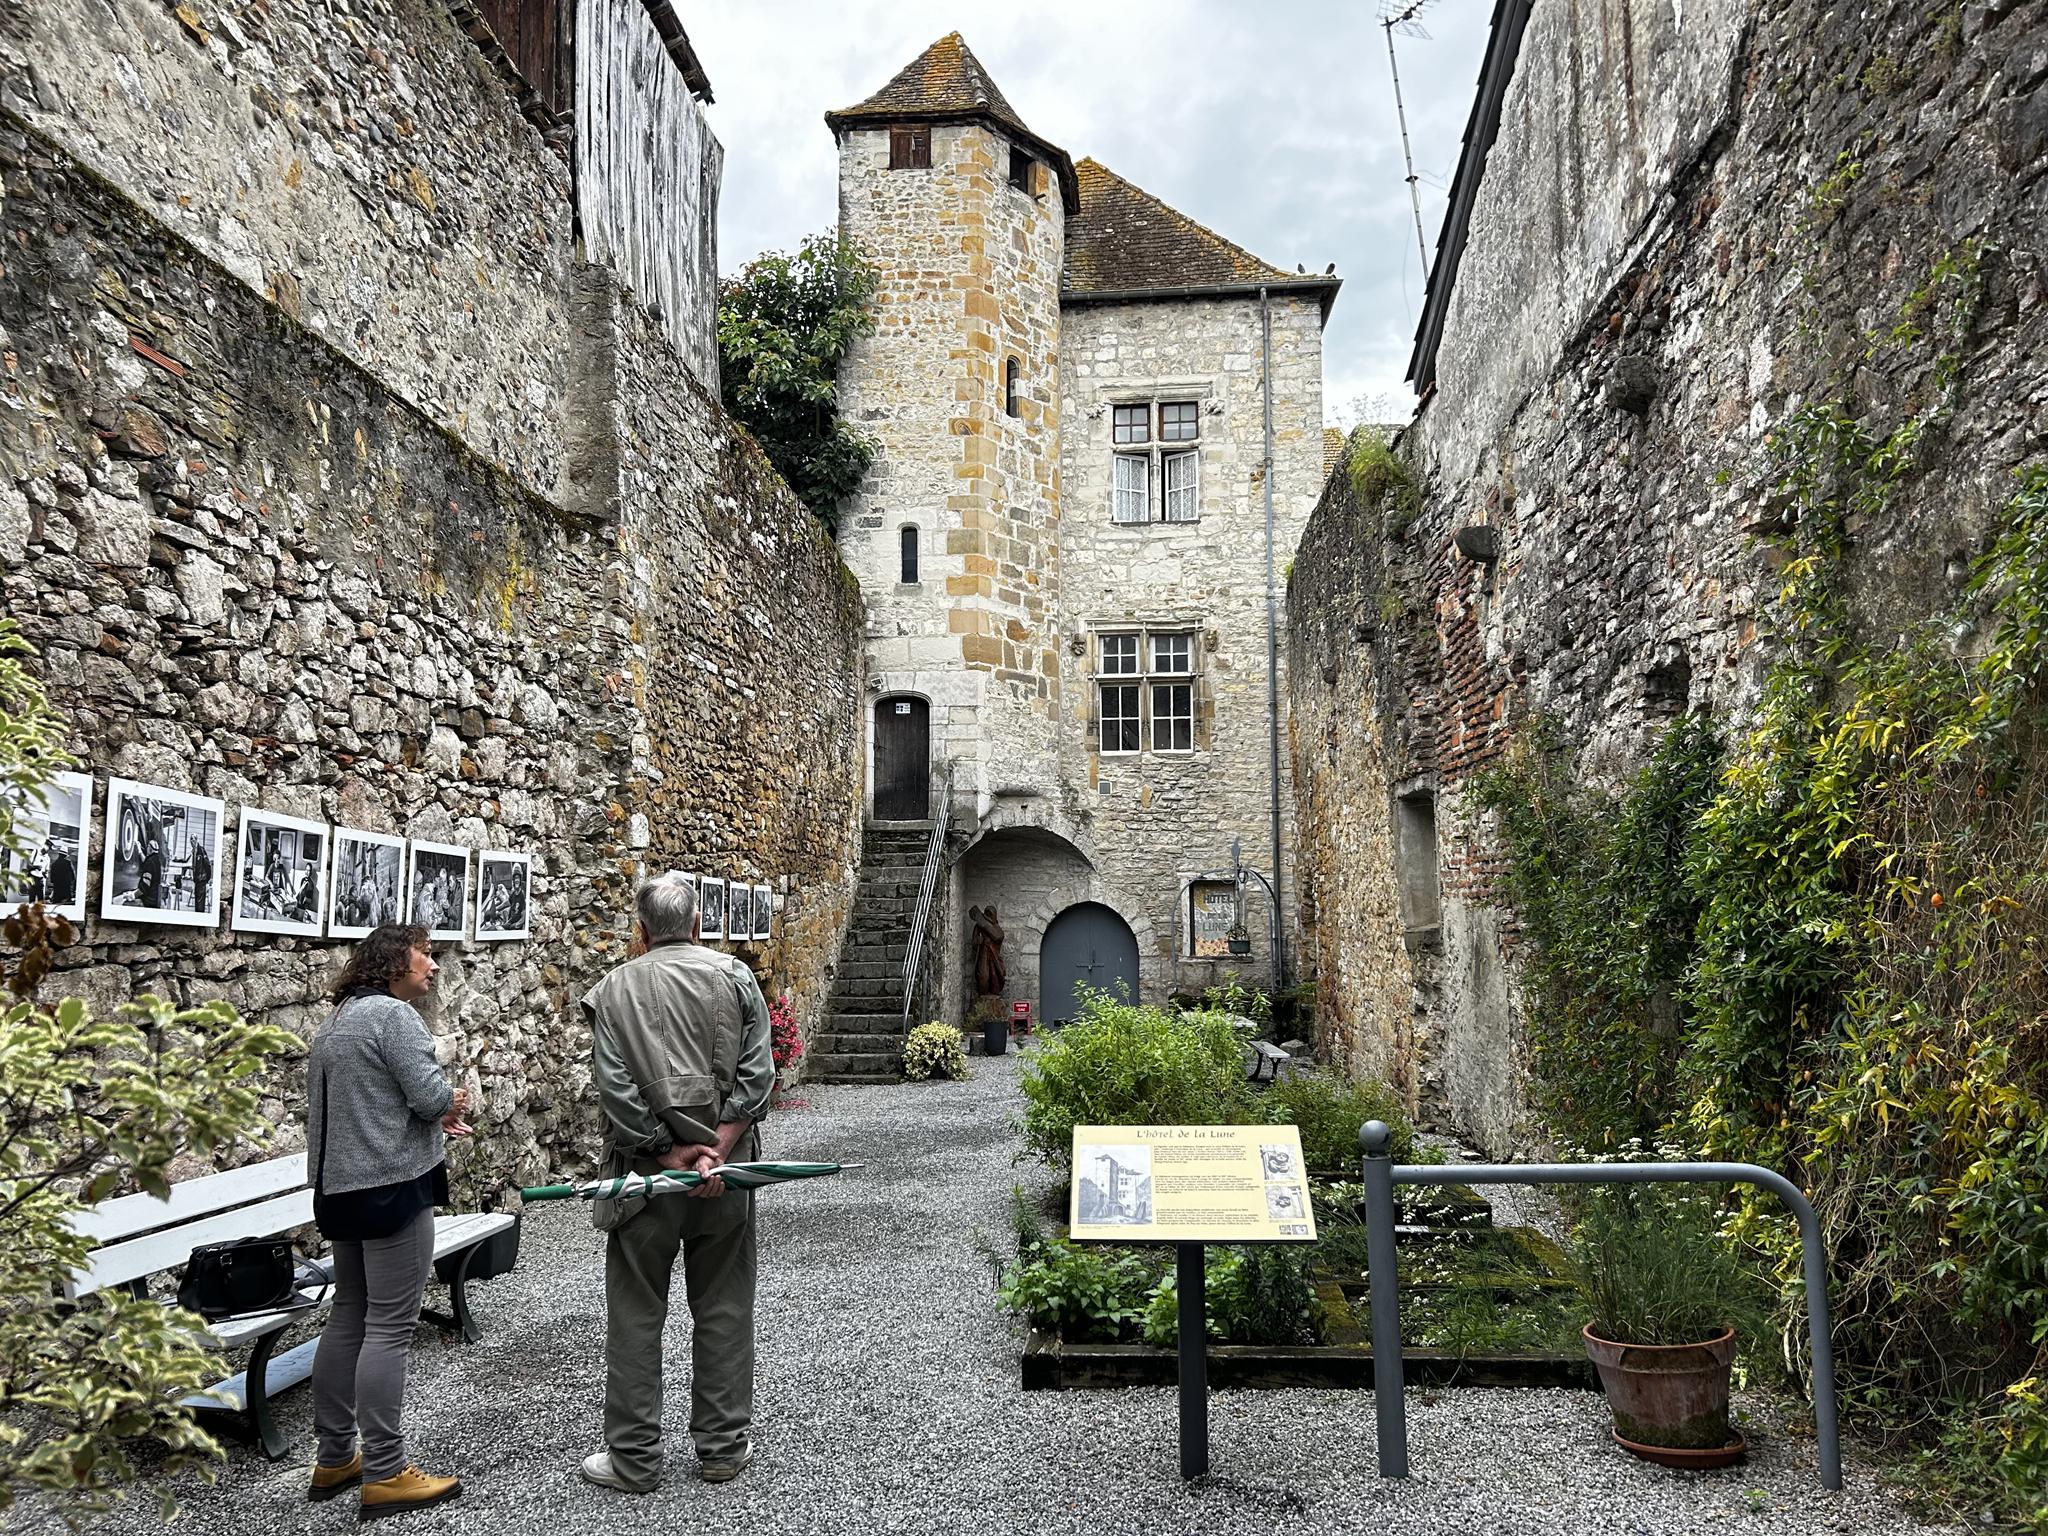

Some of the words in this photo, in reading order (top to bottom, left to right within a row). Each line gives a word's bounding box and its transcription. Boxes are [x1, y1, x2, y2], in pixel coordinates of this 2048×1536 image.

[1203, 922, 1228, 931] LUNE
[1137, 1129, 1174, 1138] L'hôtel
[1178, 1129, 1190, 1138] de
[1194, 1129, 1206, 1138] la
[1210, 1130, 1236, 1138] Lune
